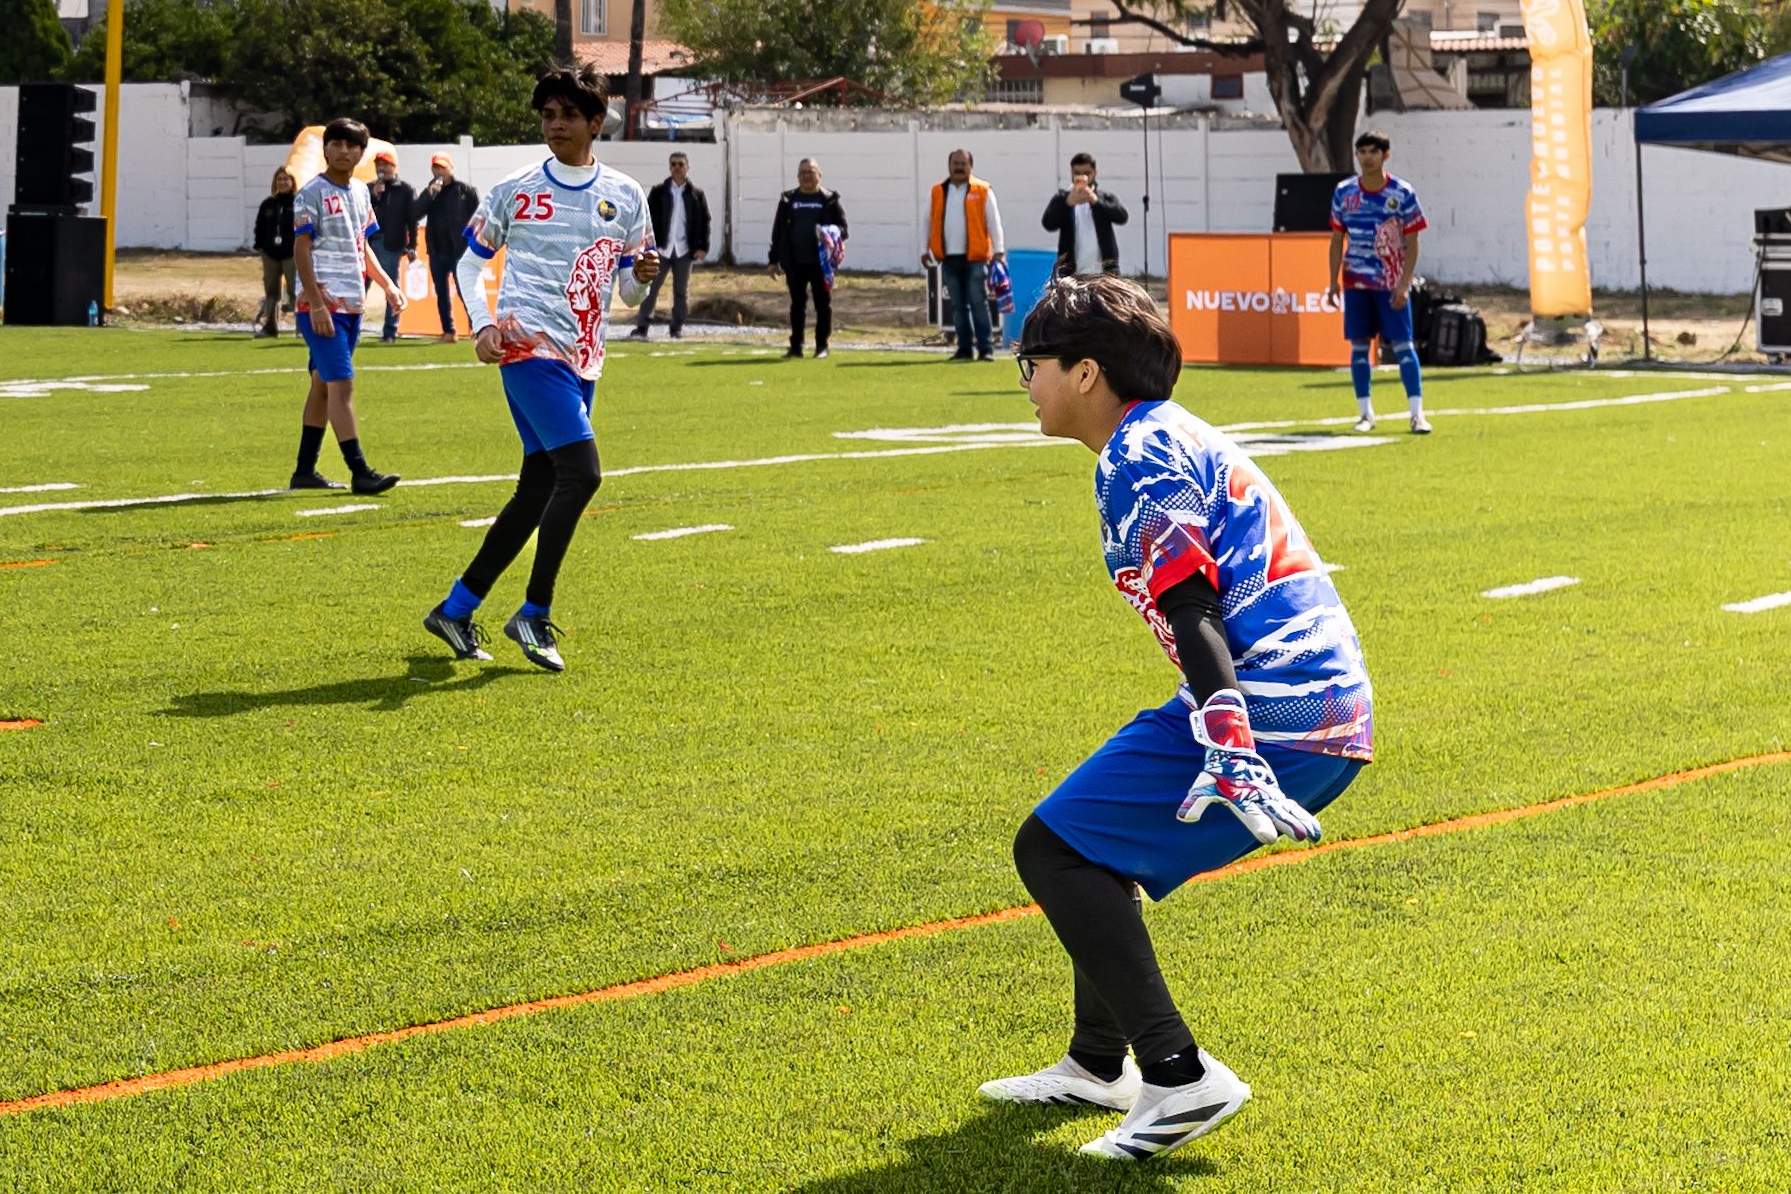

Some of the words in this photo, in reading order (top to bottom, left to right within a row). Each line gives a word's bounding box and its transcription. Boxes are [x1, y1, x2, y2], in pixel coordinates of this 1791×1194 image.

[324, 196, 342, 214] 12
[514, 193, 554, 221] 25
[1186, 290, 1270, 312] NUEVO
